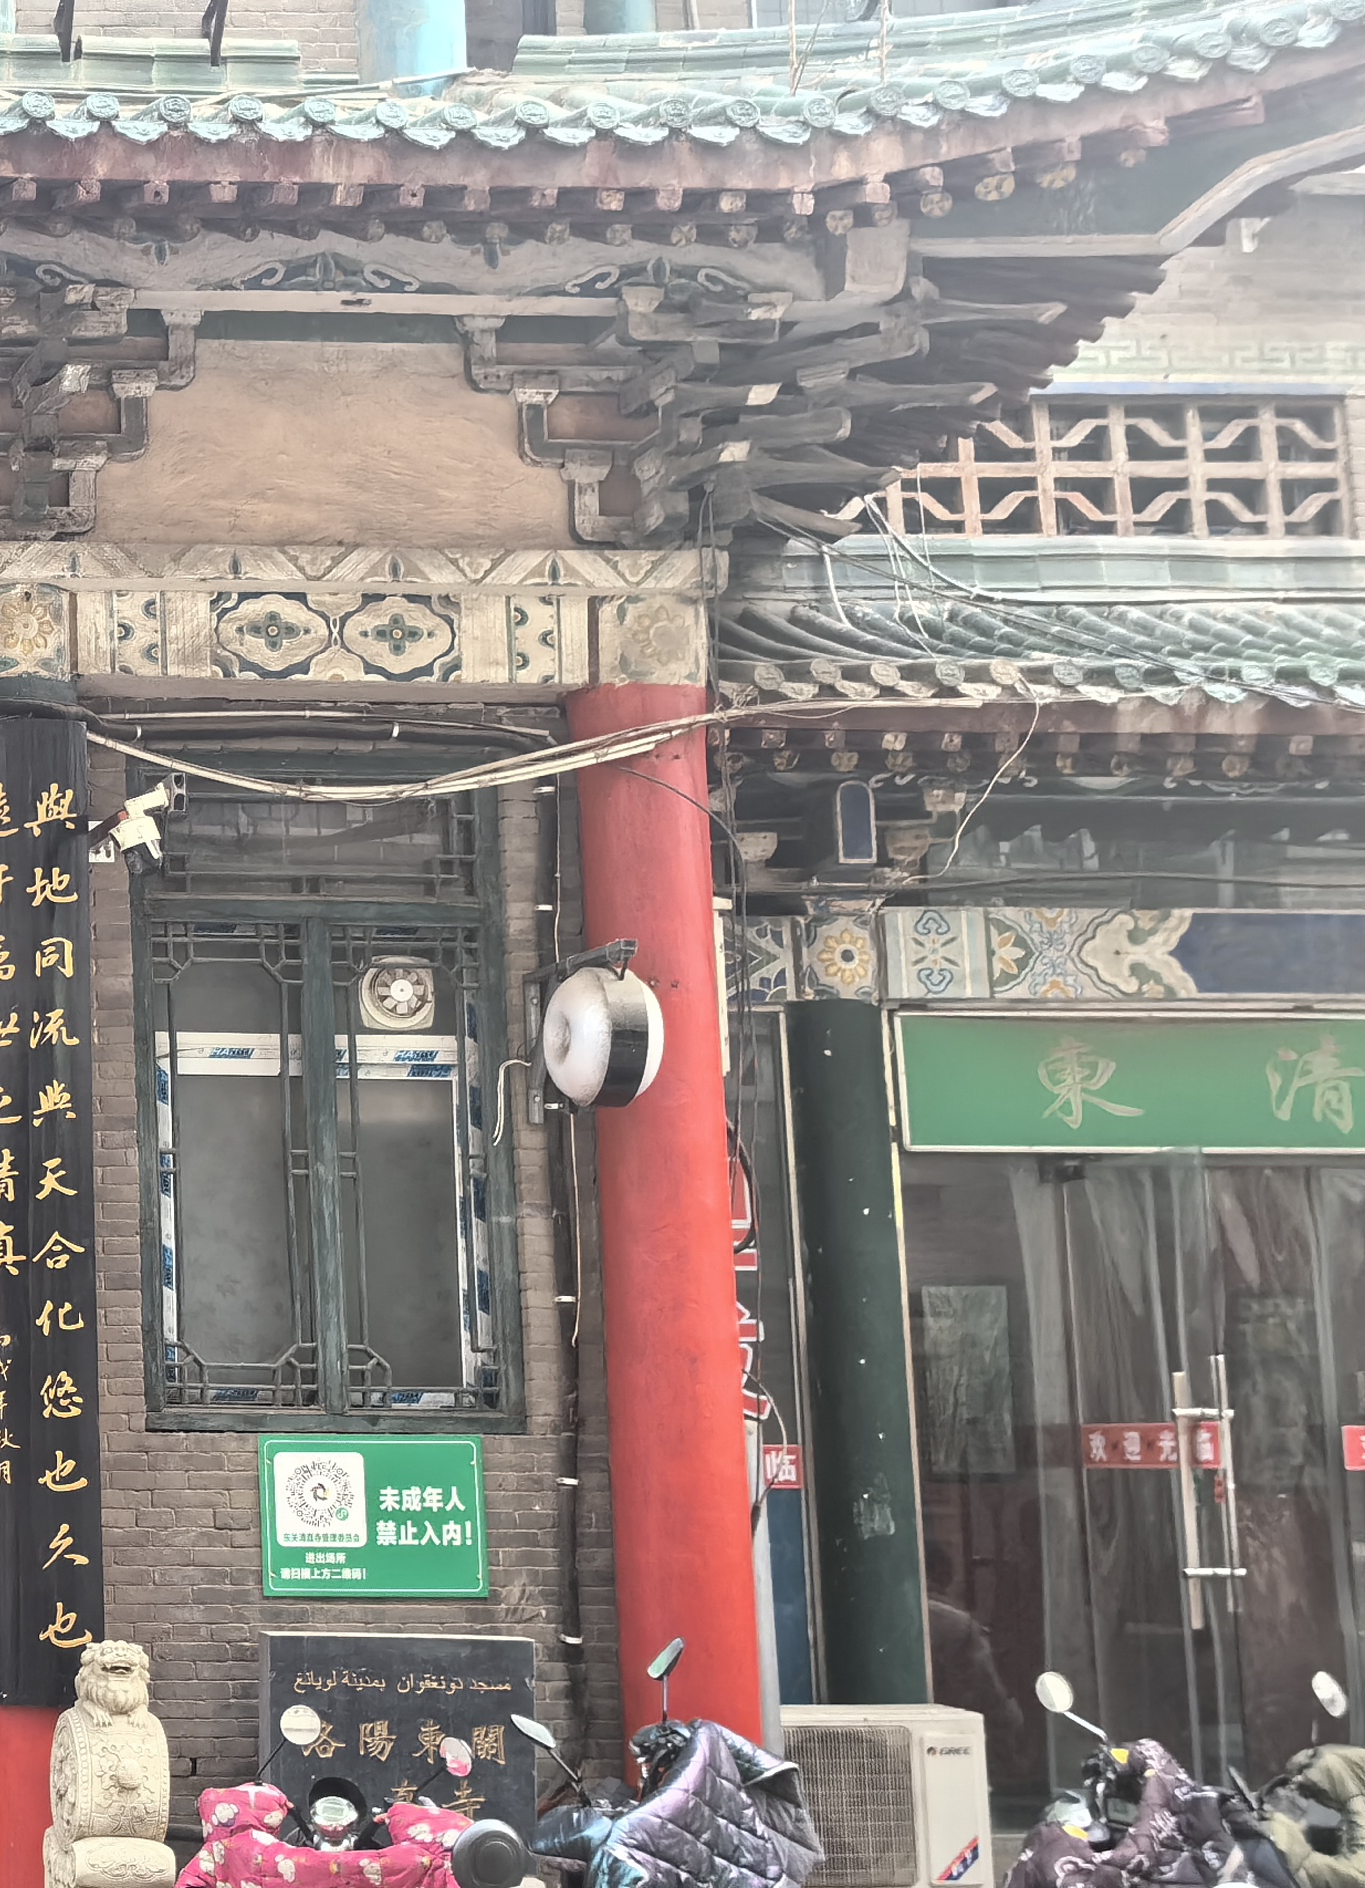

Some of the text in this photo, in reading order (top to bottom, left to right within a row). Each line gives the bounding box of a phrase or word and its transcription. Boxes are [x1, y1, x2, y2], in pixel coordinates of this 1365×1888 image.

[379, 1486, 465, 1512] 未成年人
[305, 1552, 346, 1564] 进出场所
